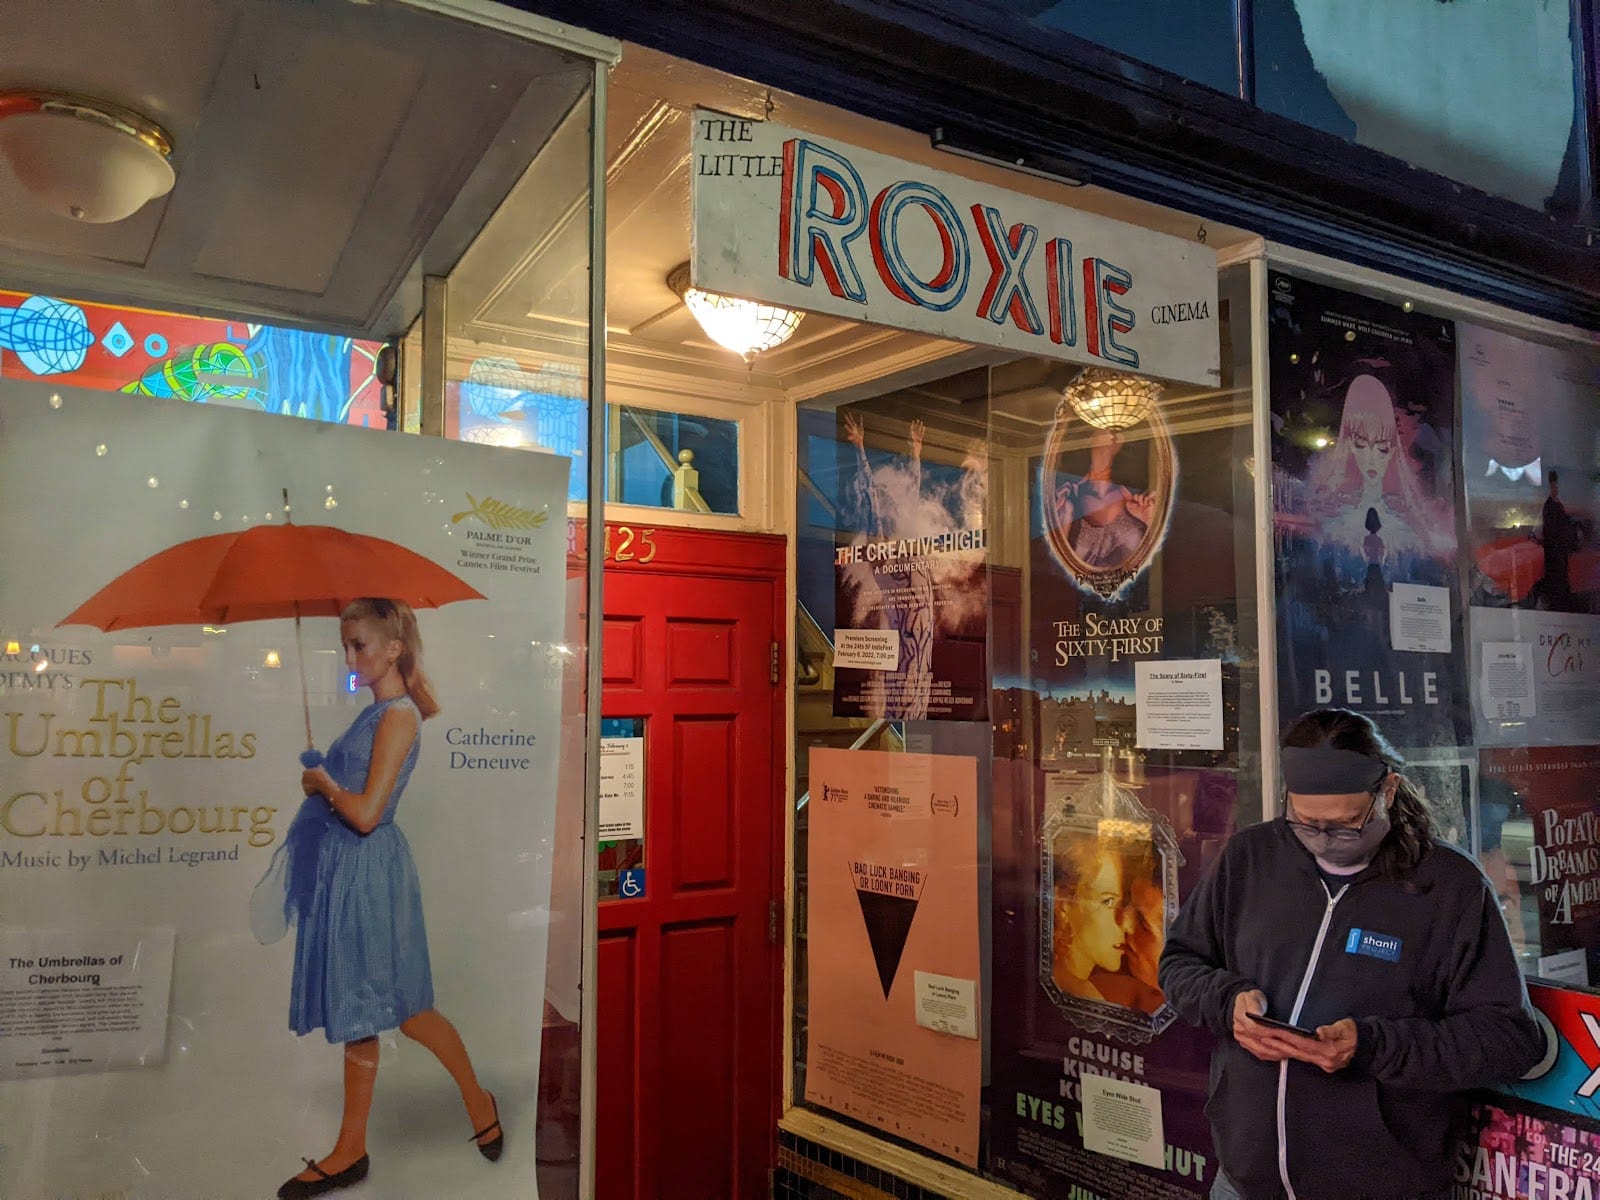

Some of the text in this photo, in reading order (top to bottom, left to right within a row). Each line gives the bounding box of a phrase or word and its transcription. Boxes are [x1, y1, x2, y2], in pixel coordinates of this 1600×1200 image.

[699, 119, 753, 143] THE
[698, 153, 785, 178] LITTLE
[778, 137, 1139, 368] ROXIE
[1150, 301, 1210, 325] CINEMA
[466, 530, 503, 542] PALME
[835, 529, 985, 565] THE CREATIVE HIGH
[457, 559, 540, 574] Cannes Film Festival
[460, 549, 490, 560] Winner
[492, 552, 517, 562] Grand
[874, 560, 941, 575] A DOCUMENTARY
[1053, 612, 1164, 637] THE SCARY OF
[838, 651, 856, 659] February
[1055, 637, 1164, 667] SIXTY-FIRST
[1149, 672, 1158, 680] The
[1314, 669, 1439, 705] BELLE
[79, 677, 183, 724] The
[4, 711, 258, 759] Umbrellas
[445, 727, 536, 747] Catherine
[449, 752, 530, 771] Deneuve
[80, 758, 143, 804] of
[0, 789, 278, 848] Cherbourg
[0, 844, 240, 872] Music by Michel Legrand
[1527, 844, 1598, 886] DREAMS
[854, 862, 921, 885] BAD LUCK BANGING
[860, 876, 914, 897] OR LOONY PORN
[1545, 884, 1558, 903] OF
[1361, 945, 1396, 956] PROJECT
[1363, 935, 1398, 951] shanti
[9, 955, 124, 969] The Umbrellas of
[28, 973, 100, 985] Cherbourg
[1068, 1037, 1144, 1074] CRUISE
[1102, 1089, 1115, 1098] Eyes
[1115, 1092, 1128, 1101] Wide
[1016, 1092, 1065, 1130] EYES
[1454, 1141, 1517, 1199] SAN
